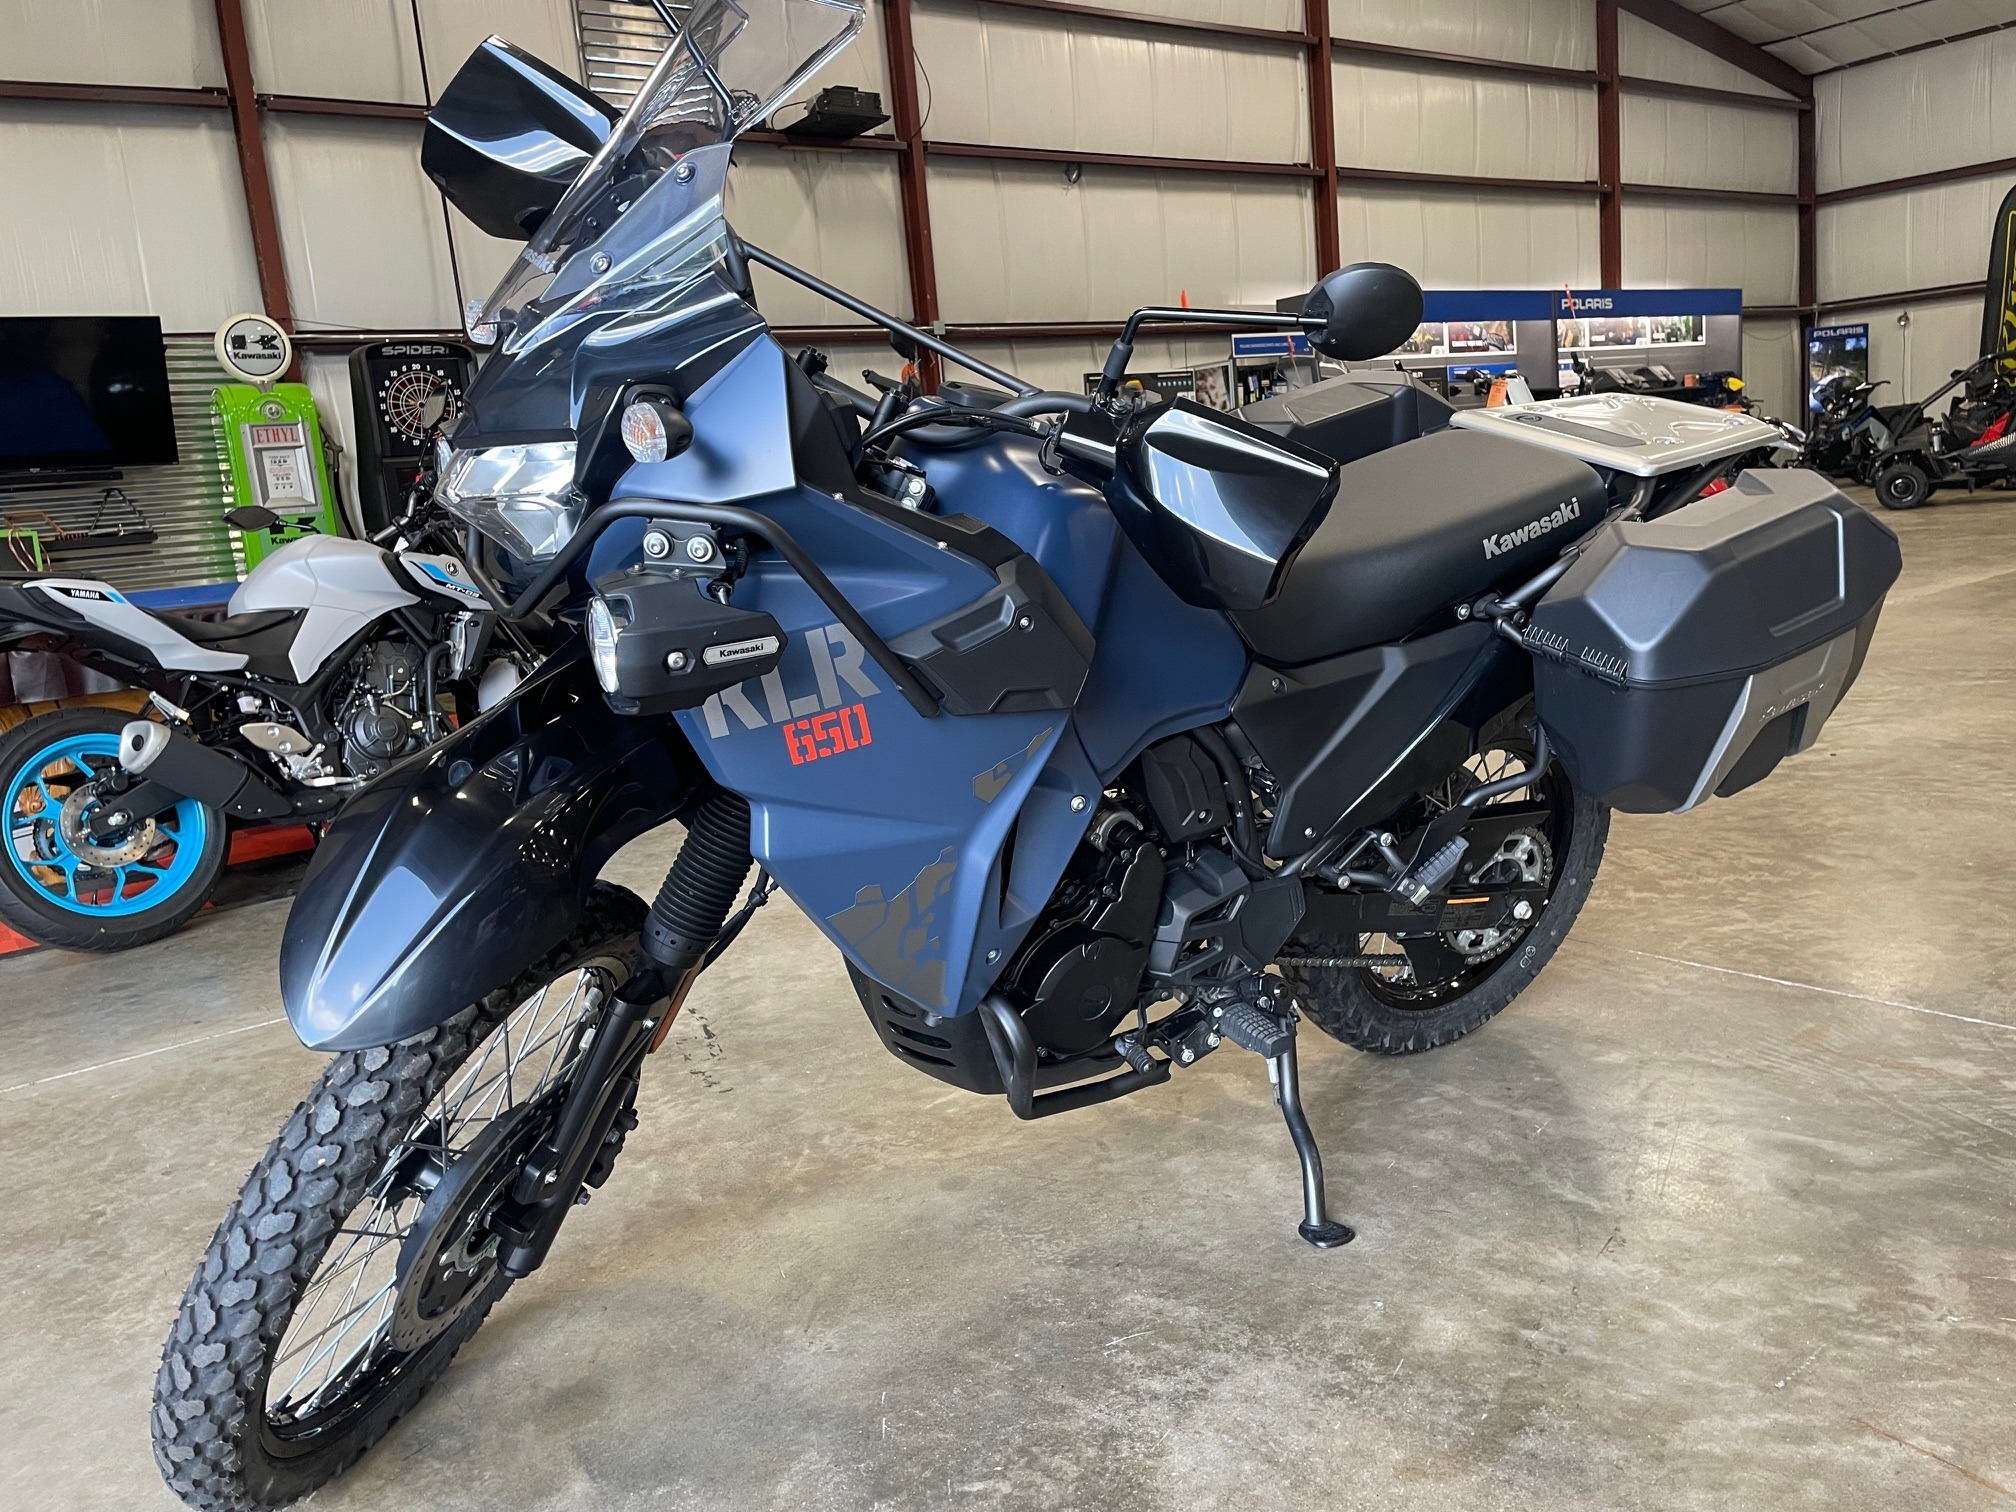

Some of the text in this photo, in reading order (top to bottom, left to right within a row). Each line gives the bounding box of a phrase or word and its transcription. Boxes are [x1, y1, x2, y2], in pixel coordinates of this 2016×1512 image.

[522, 248, 556, 274] asaki
[1561, 298, 1613, 310] POLARIS
[1813, 326, 1864, 338] POLARIS
[233, 351, 281, 360] Kawasaki
[381, 345, 446, 356] SPIDER
[255, 426, 298, 443] ETHYL
[1482, 496, 1580, 560] Kawasaki
[71, 589, 100, 600] YAMAHA
[719, 643, 764, 658] Kawasaki
[702, 622, 881, 739] KLR
[783, 703, 873, 766] 650
